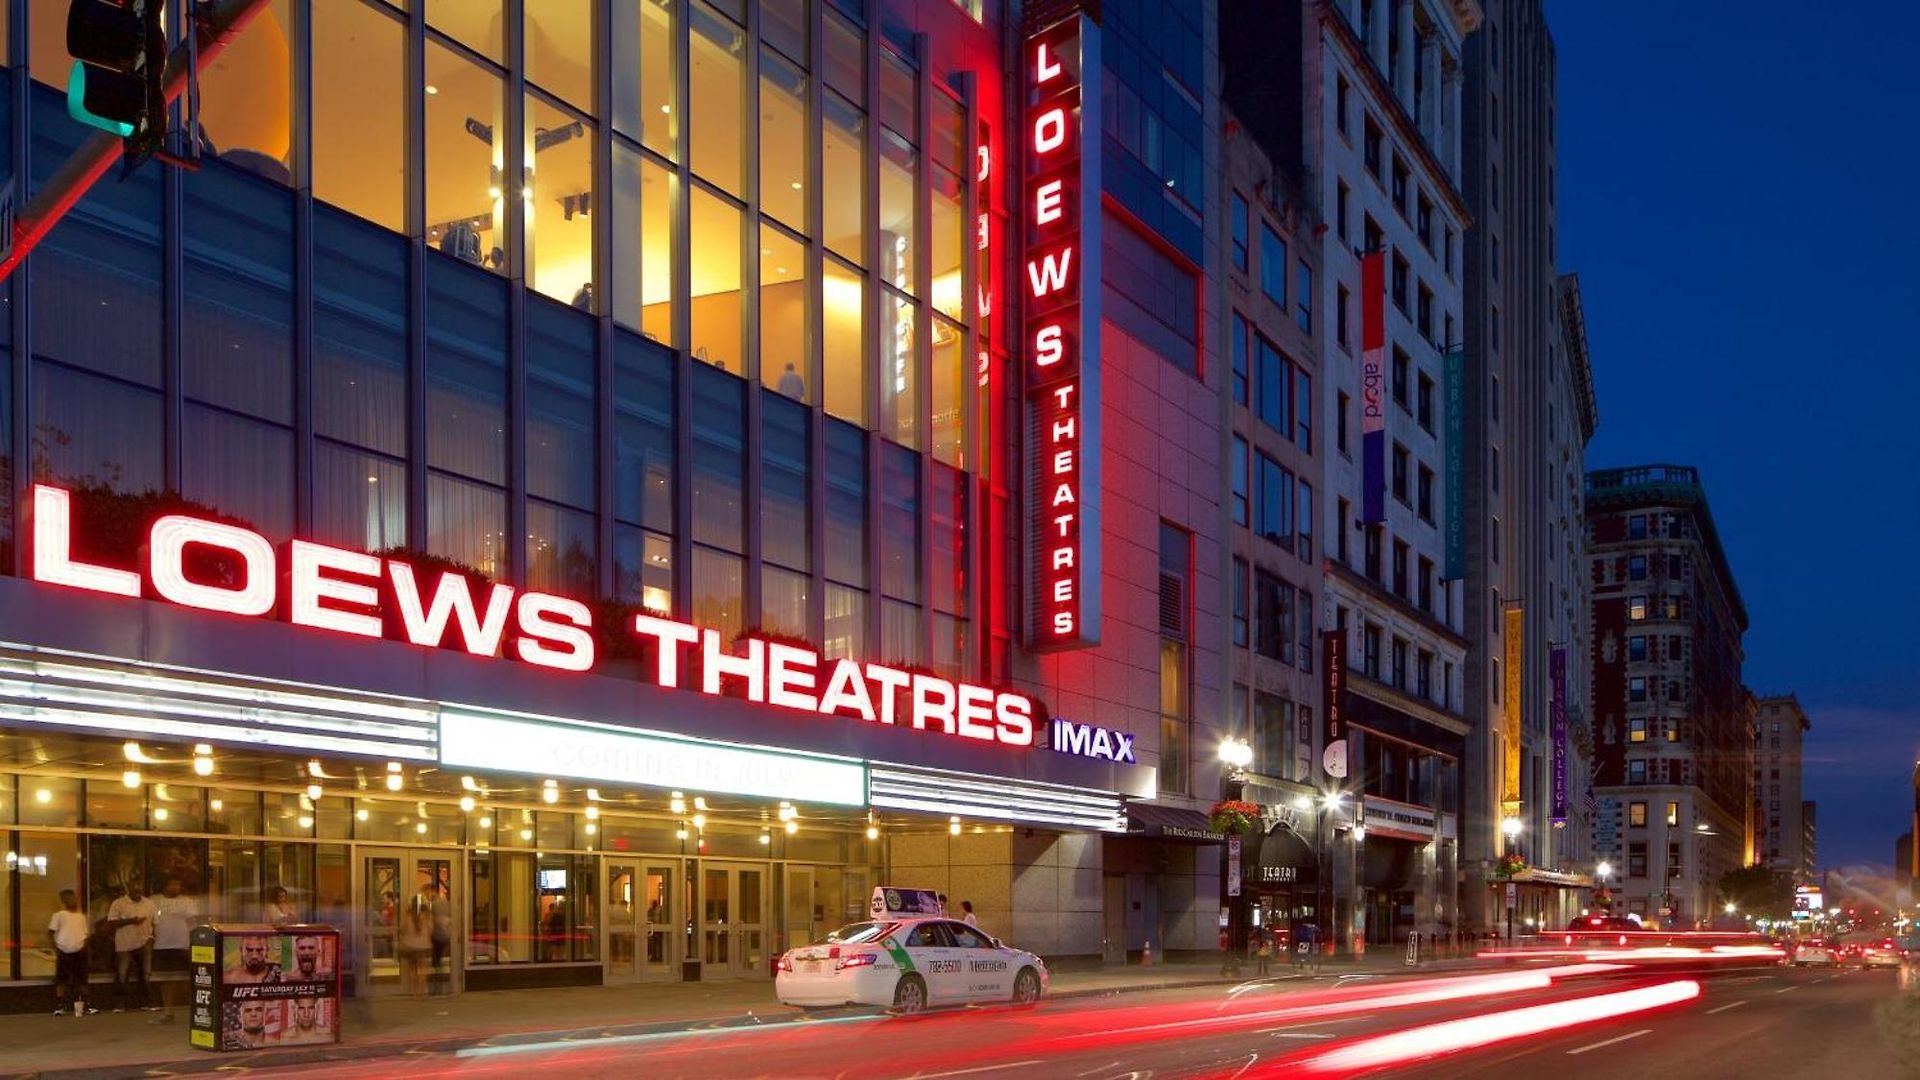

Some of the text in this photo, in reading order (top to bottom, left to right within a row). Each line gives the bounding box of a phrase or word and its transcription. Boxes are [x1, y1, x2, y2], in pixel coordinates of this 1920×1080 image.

[1028, 43, 1074, 634] LOEWS THEATRES
[1450, 358, 1460, 548] URBAN COLLEGE
[34, 483, 1033, 747] LOEWS THEATRES
[1331, 639, 1339, 737] TEATRO
[553, 740, 793, 788] COMING IN JULY
[1053, 719, 1135, 763] IMAX
[196, 989, 211, 1005] UFC
[232, 987, 259, 998] UFC
[261, 985, 293, 993] SATURDAY
